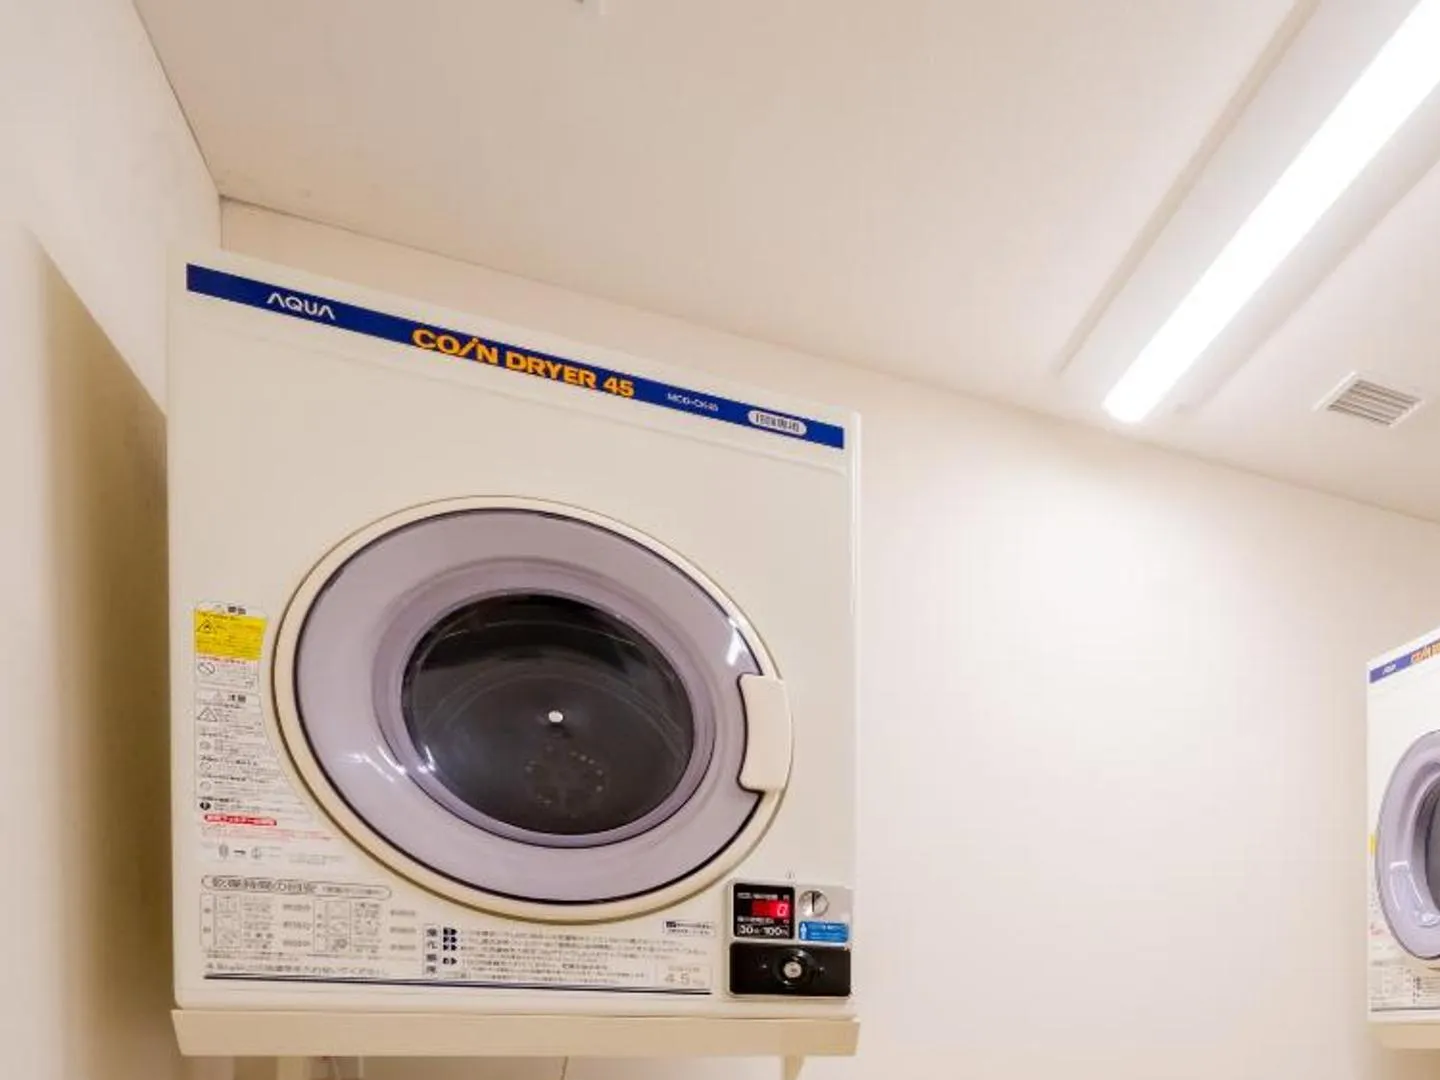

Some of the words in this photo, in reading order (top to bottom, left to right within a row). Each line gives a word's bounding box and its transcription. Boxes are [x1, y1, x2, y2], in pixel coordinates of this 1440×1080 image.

[267, 291, 336, 321] AQUA
[412, 329, 498, 365] COIN
[506, 351, 597, 390] DRYER
[603, 377, 635, 398] 45
[776, 902, 790, 917] 0
